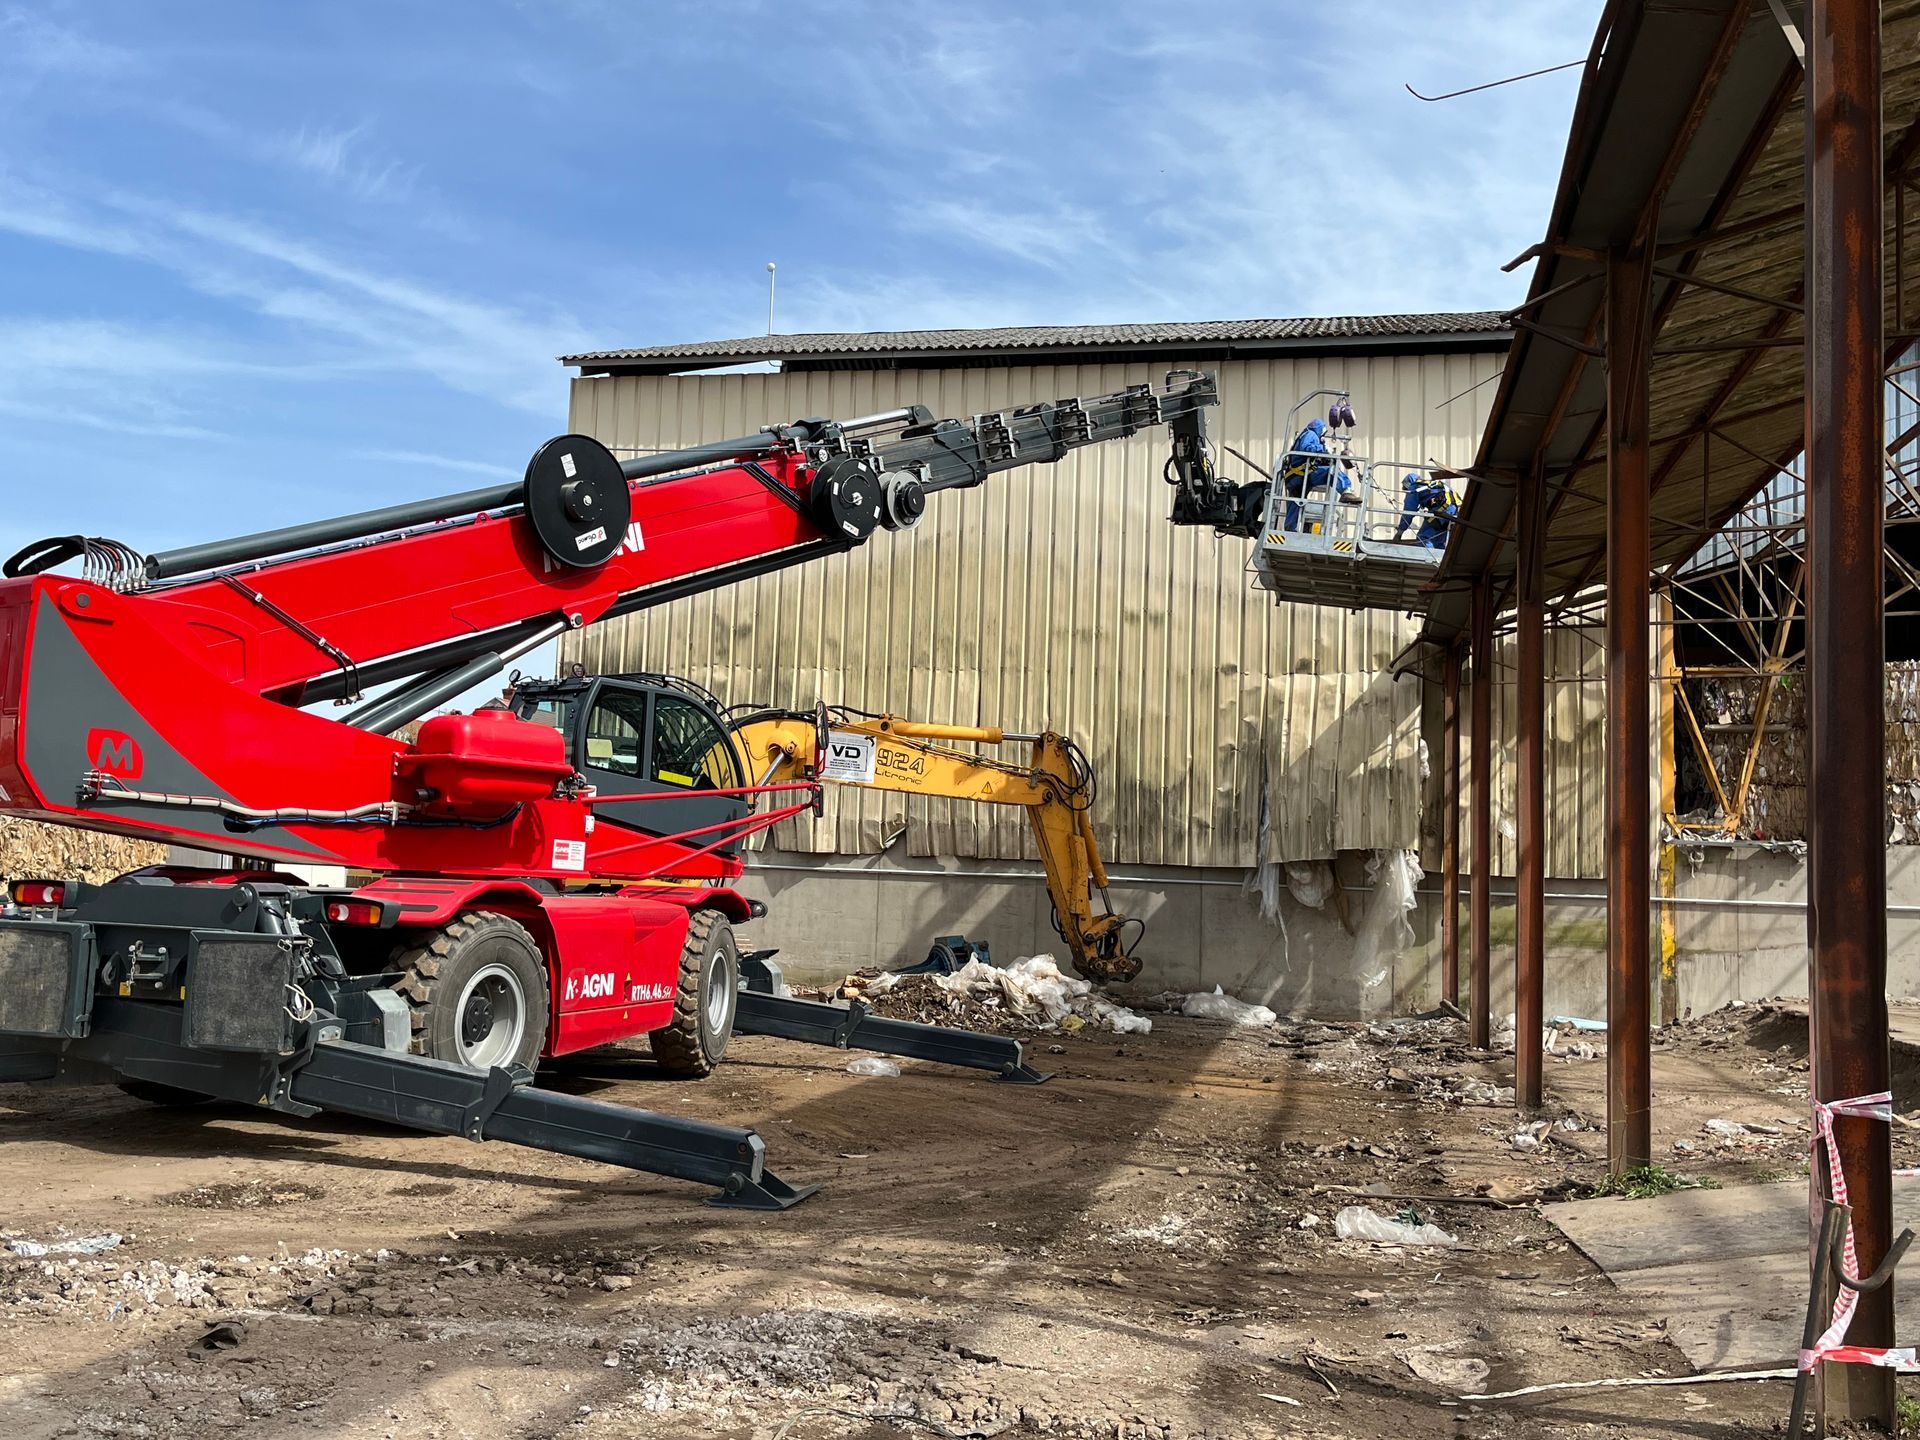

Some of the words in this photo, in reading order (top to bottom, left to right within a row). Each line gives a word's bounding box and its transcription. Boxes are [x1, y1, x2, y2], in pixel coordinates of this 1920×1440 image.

[97, 738, 133, 770] M
[831, 744, 861, 758] VD
[877, 748, 924, 775] 924
[875, 767, 922, 785] Litronic
